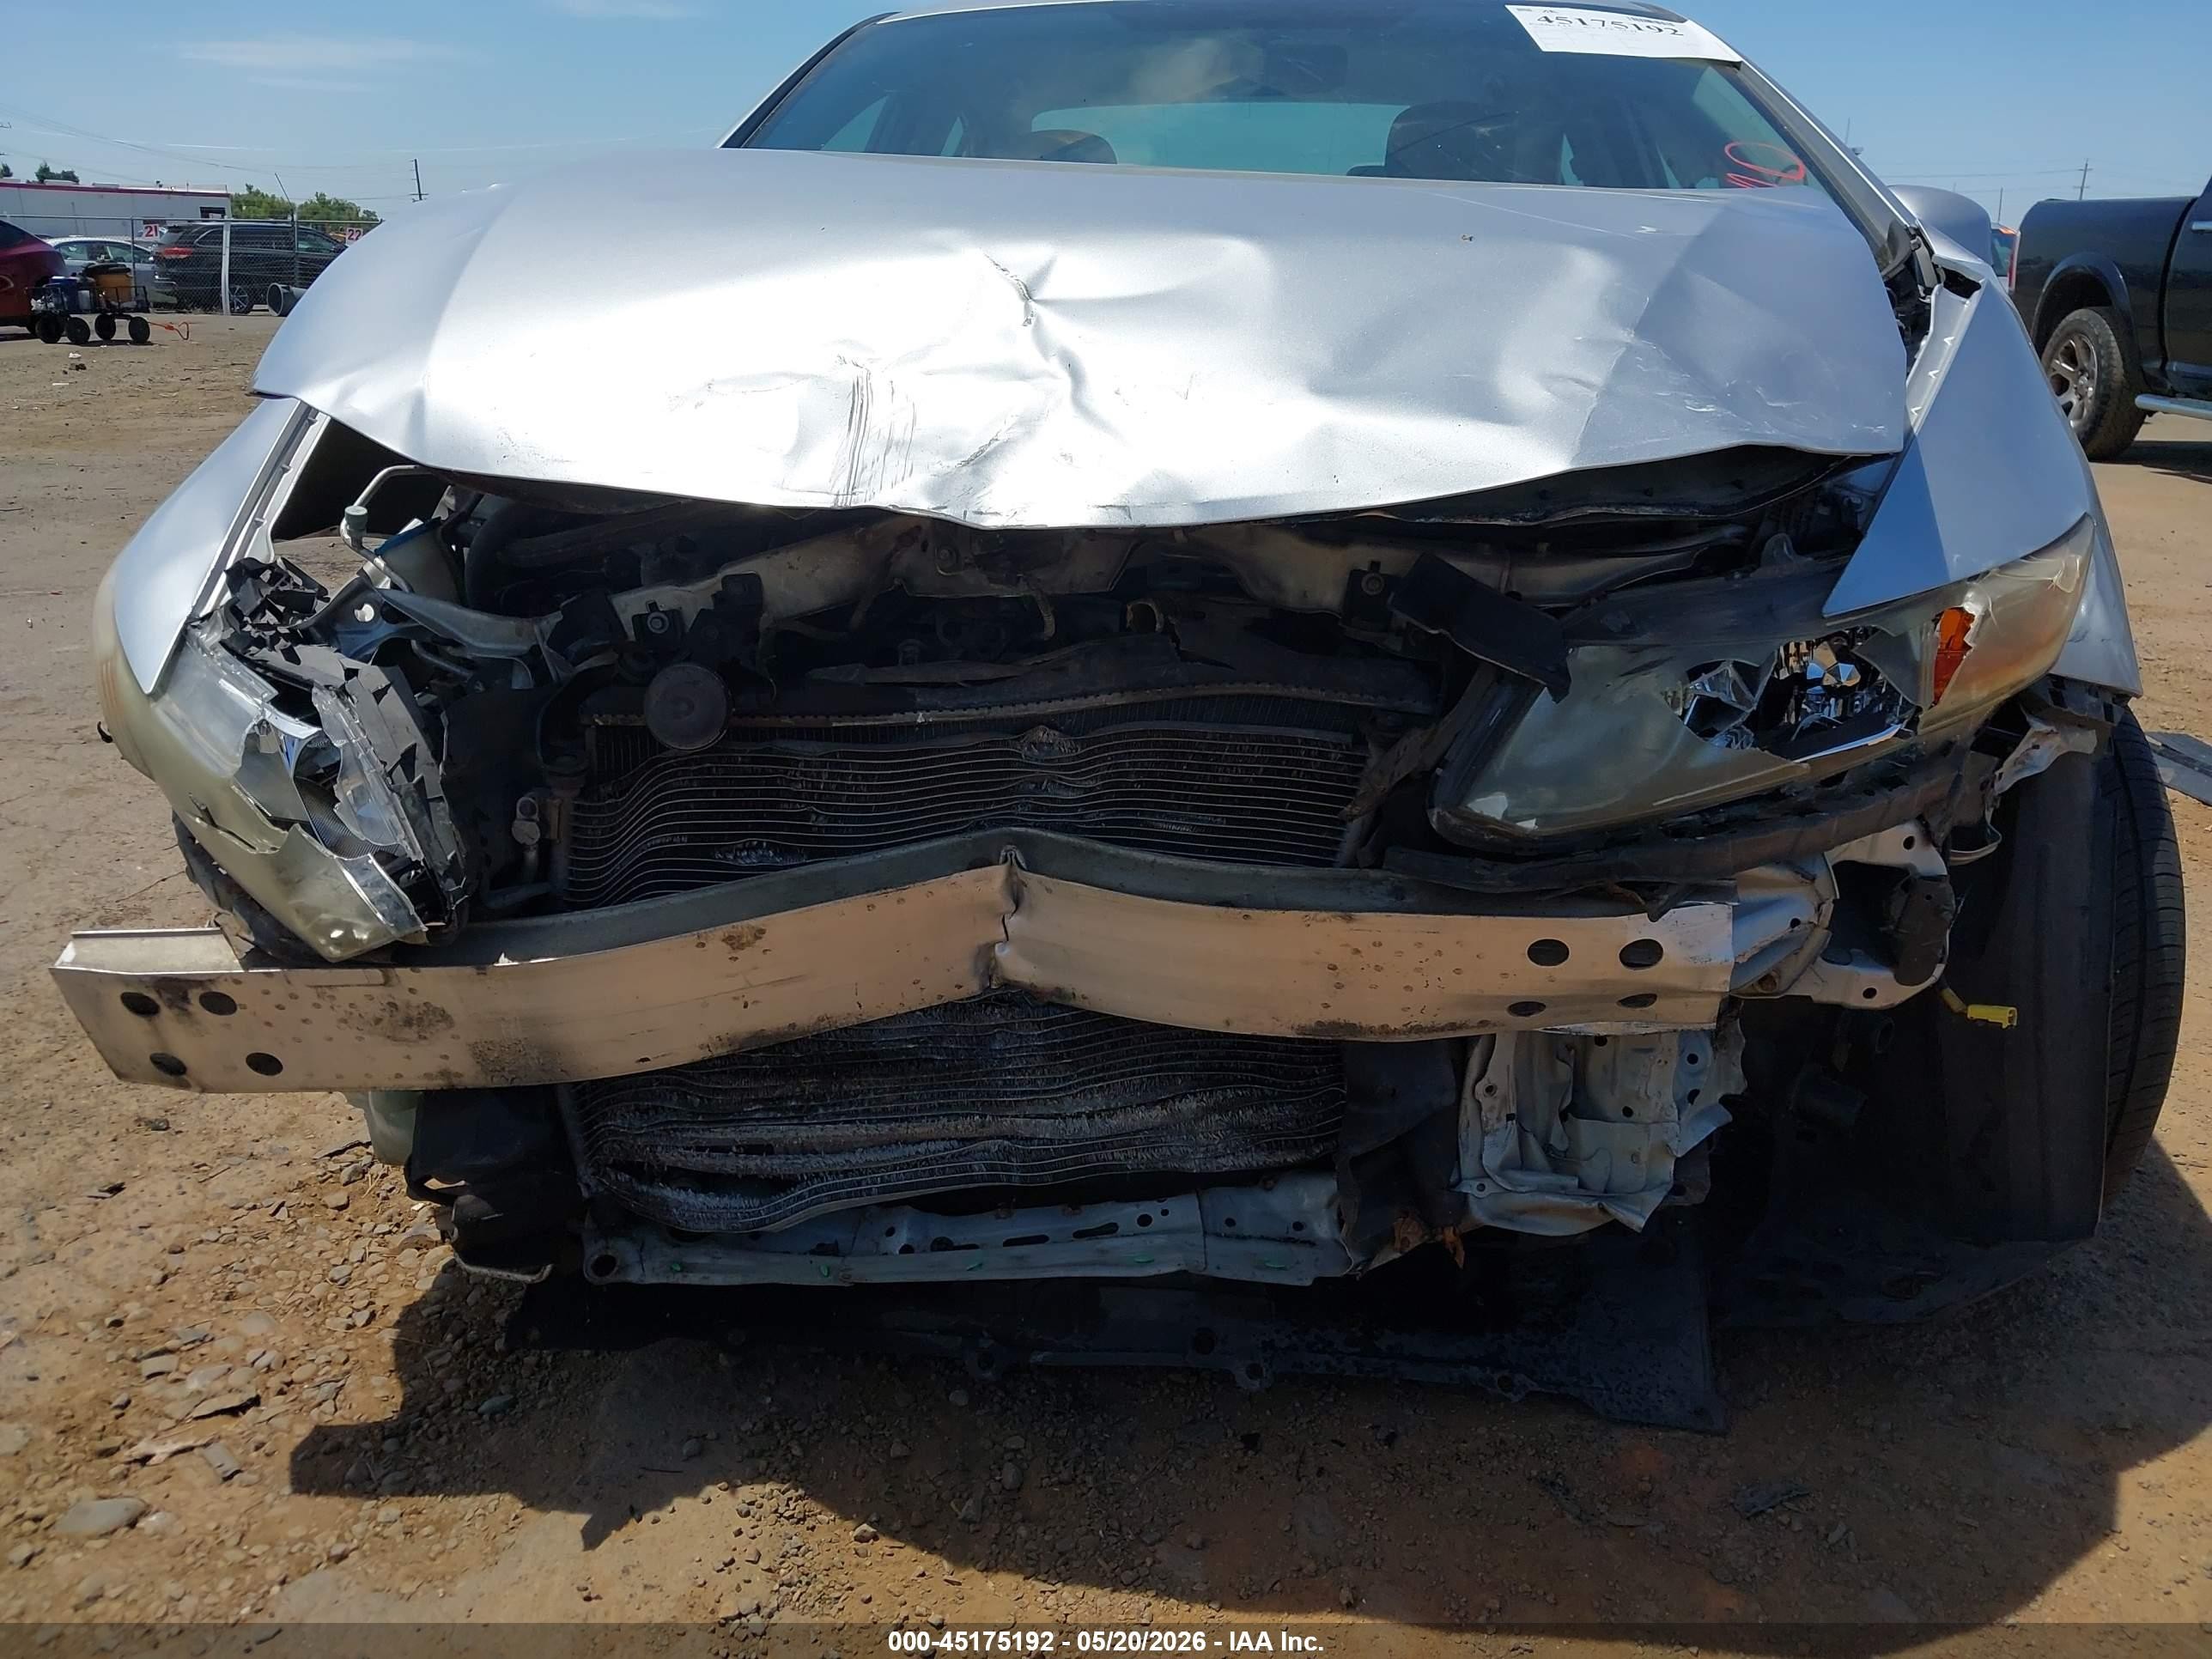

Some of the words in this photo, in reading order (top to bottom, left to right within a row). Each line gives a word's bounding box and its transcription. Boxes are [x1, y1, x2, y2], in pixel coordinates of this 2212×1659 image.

[1537, 15, 1684, 36] 45175192
[144, 225, 158, 238] 21
[348, 228, 362, 240] 22
